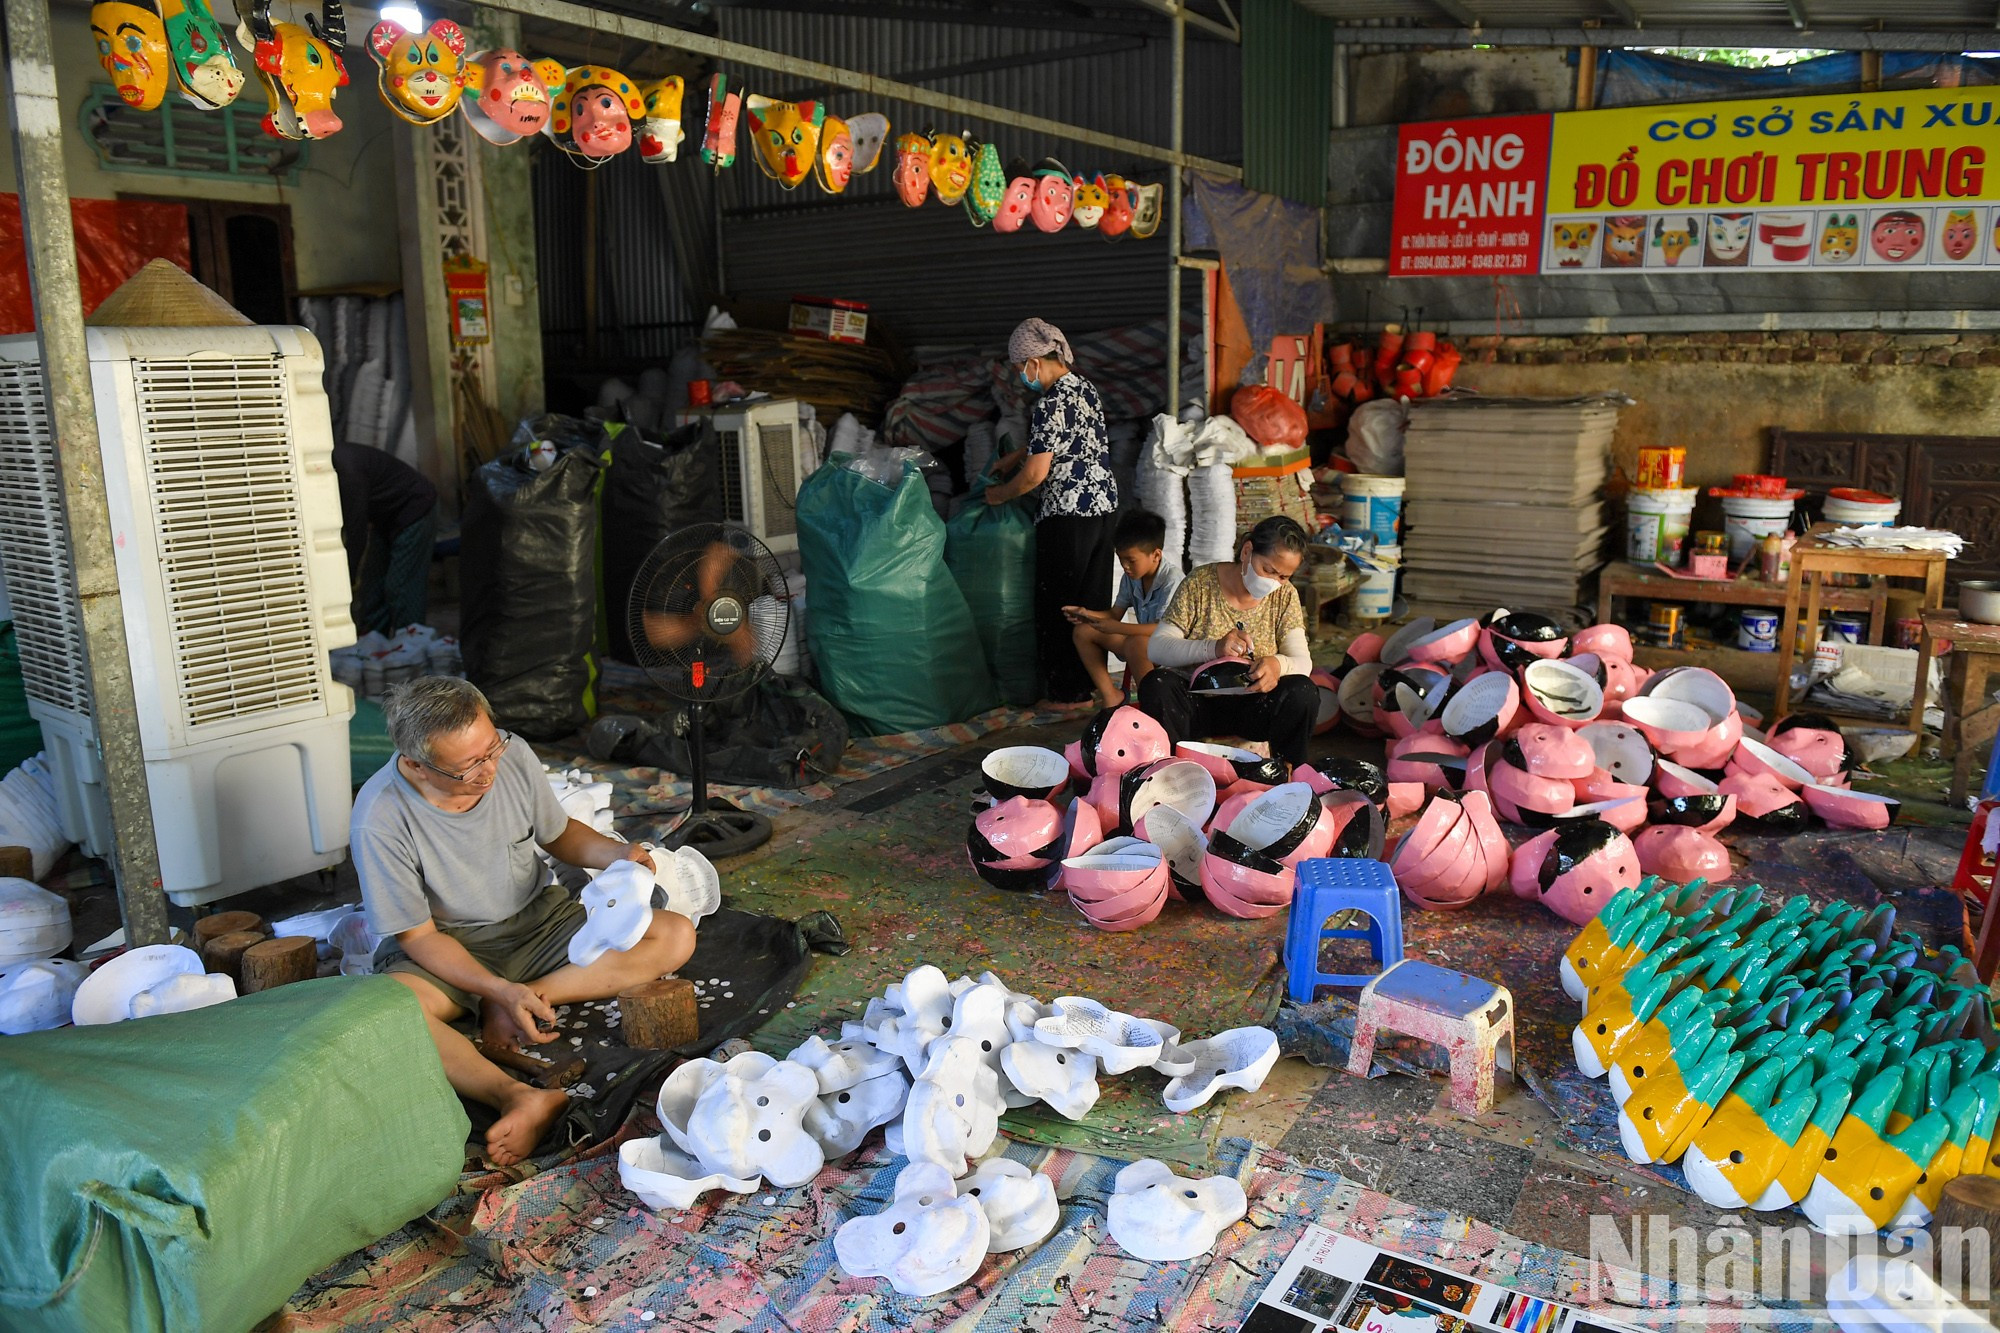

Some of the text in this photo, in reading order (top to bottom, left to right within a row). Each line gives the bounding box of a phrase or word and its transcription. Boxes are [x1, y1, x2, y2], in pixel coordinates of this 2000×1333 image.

[1648, 100, 2000, 142] CƠ SỞ SẢN XU
[1405, 127, 1525, 174] ĐÔNG
[1574, 145, 1987, 209] ĐỒ CHƠI TRUNG
[1423, 180, 1536, 229] HẠNH
